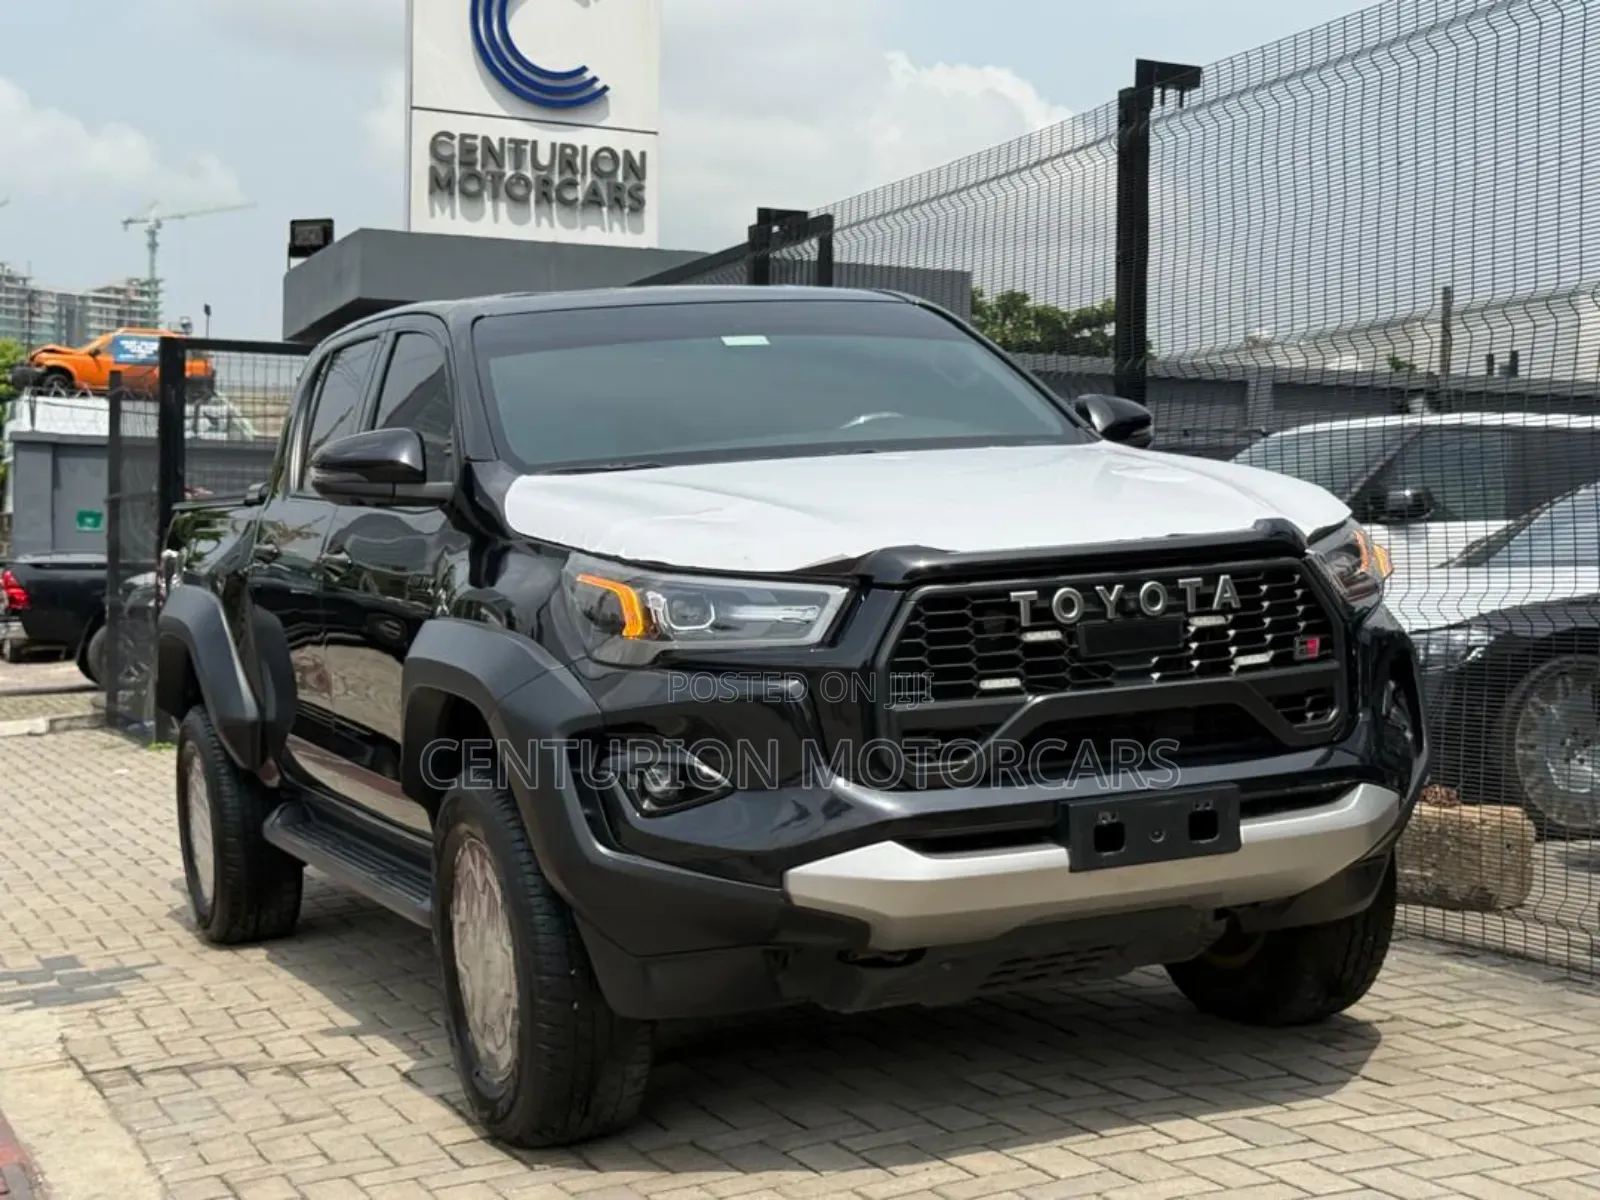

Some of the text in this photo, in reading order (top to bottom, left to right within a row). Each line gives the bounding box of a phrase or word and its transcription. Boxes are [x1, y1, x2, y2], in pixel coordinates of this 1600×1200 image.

[429, 131, 647, 181] CENTURION
[428, 165, 646, 213] MOTORCARS
[1009, 574, 1242, 627] TOYOTA
